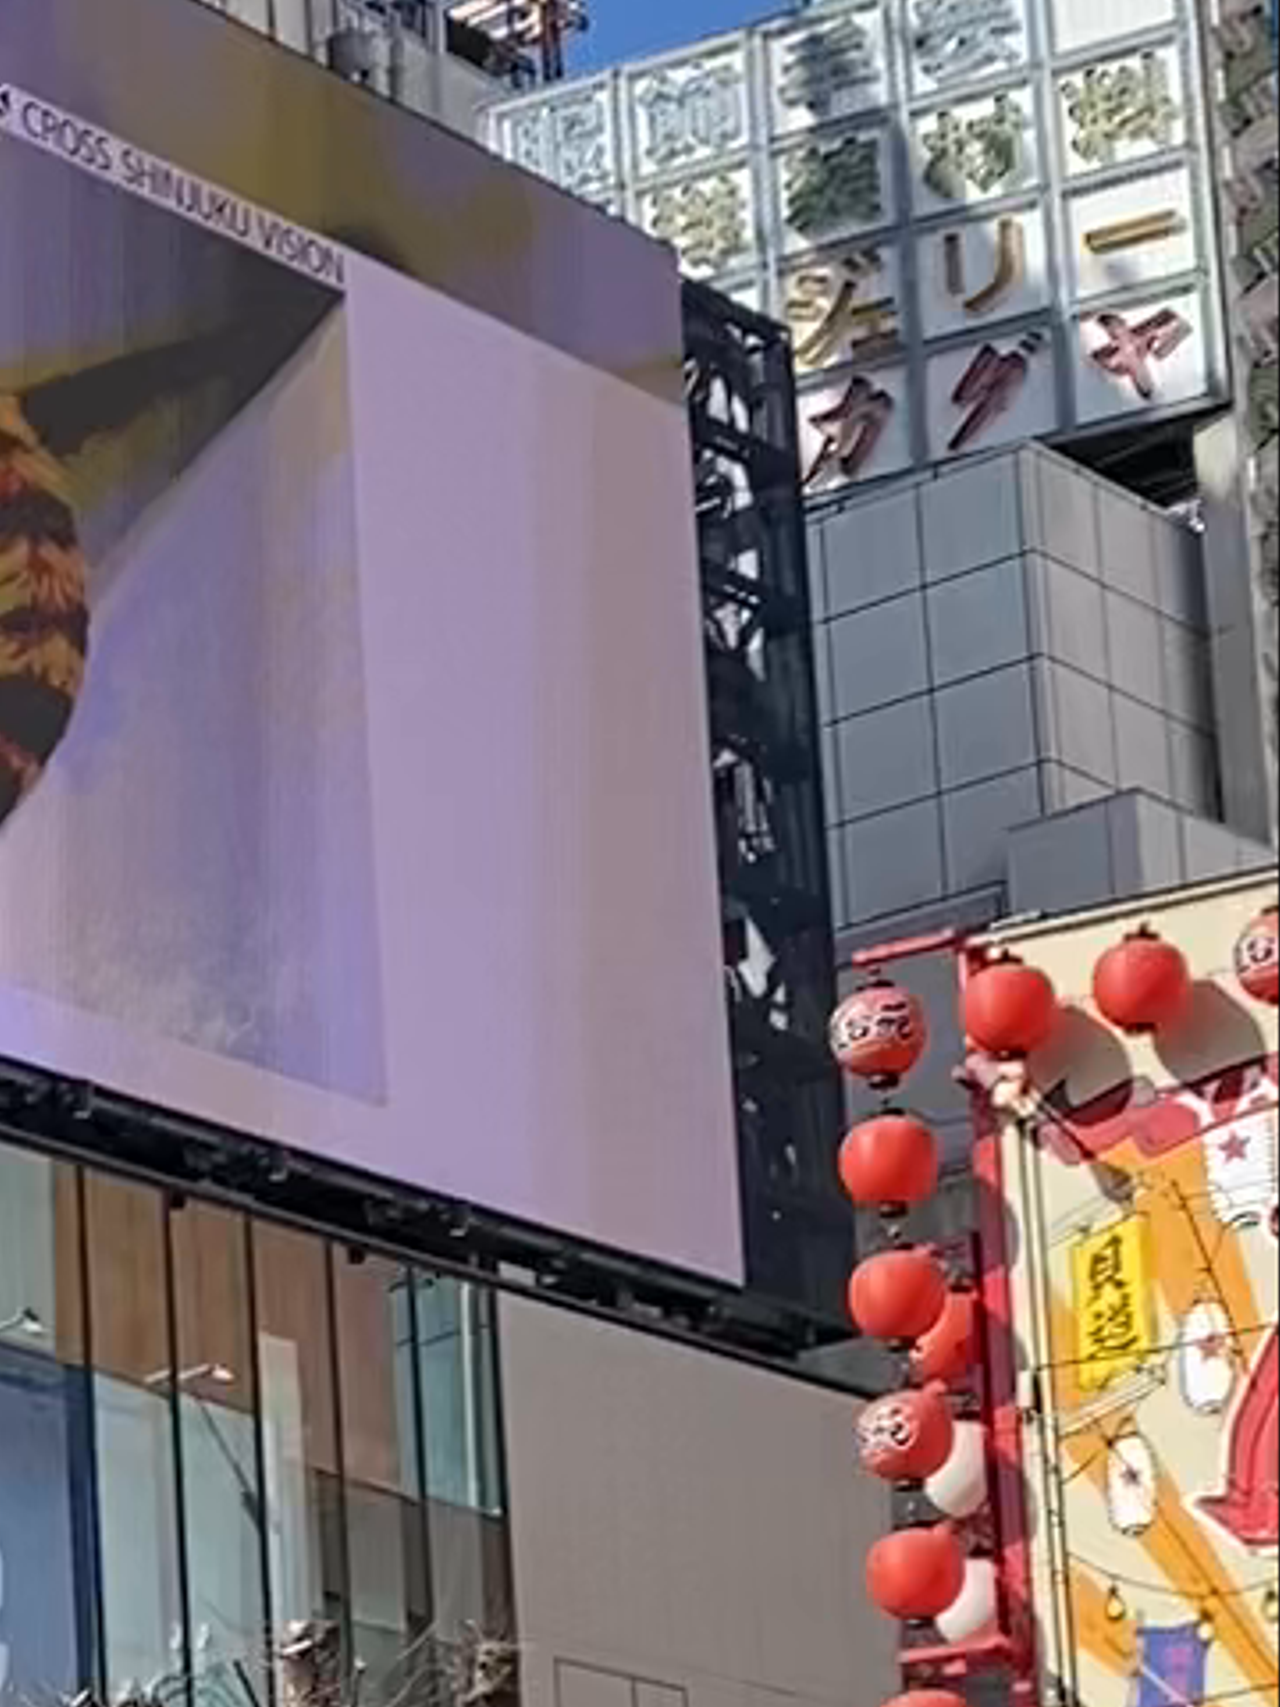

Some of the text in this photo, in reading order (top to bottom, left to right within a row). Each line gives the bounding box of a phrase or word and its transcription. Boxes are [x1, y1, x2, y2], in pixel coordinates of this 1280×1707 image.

[20, 96, 346, 285] CROSS SHINJUKU VISION
